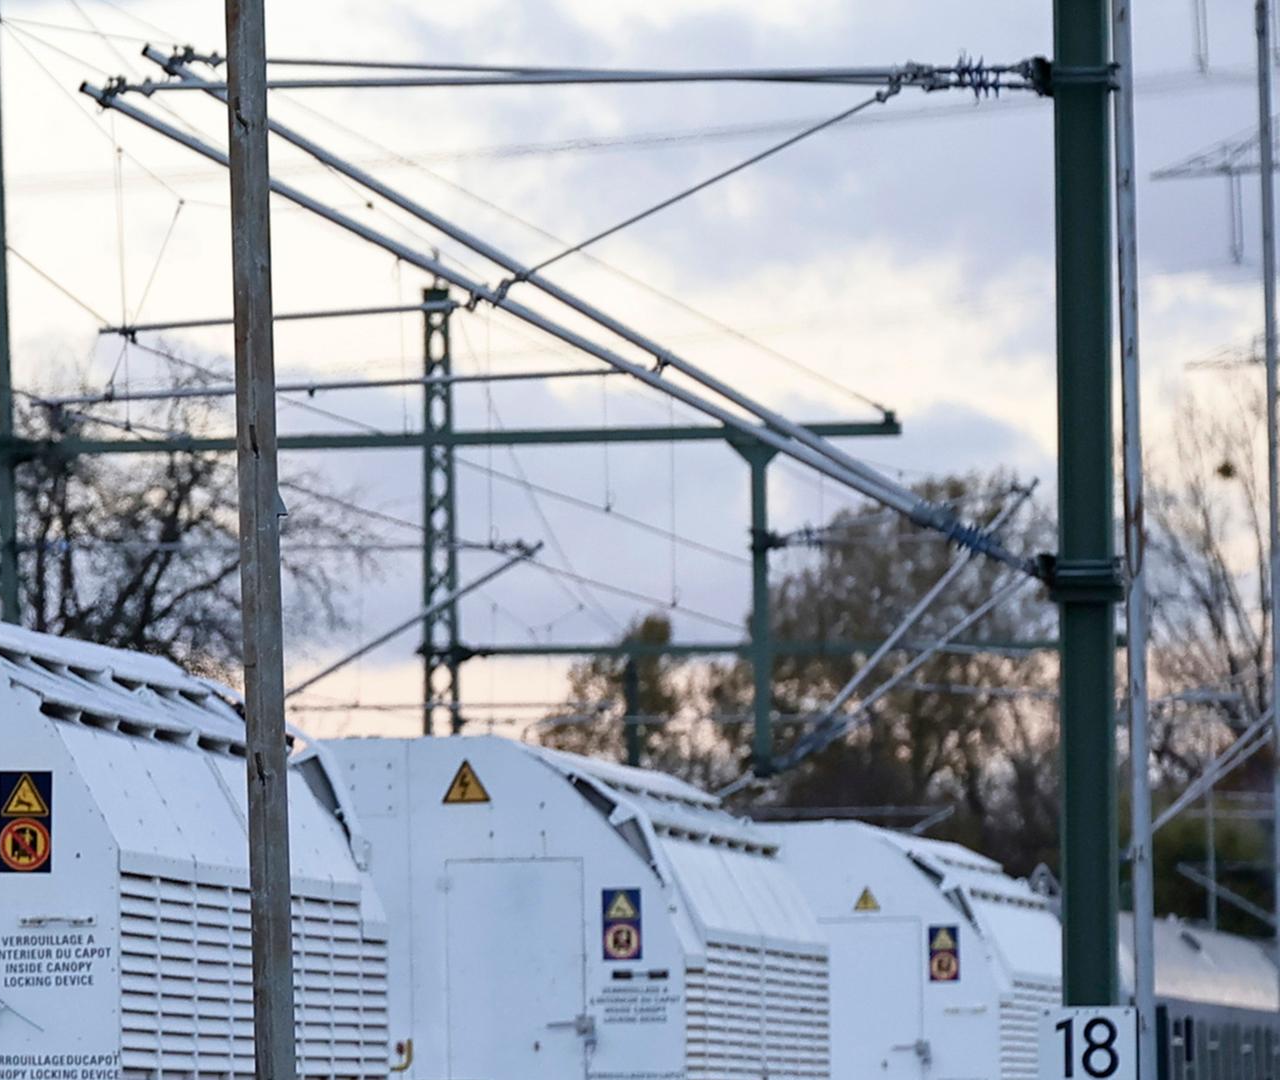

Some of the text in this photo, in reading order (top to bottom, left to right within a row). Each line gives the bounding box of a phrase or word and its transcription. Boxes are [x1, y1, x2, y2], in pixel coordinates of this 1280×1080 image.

[1, 934, 95, 947] VERROUILLAGE A
[56, 948, 72, 959] DU
[75, 947, 111, 959] CAPOT
[5, 962, 92, 974] INSIDE CANOPY
[4, 975, 94, 987] LOCKING DEVICE
[1055, 1017, 1119, 1079] 18
[30, 1069, 78, 1080] LOCKING
[81, 1068, 119, 1079] DEVICE
